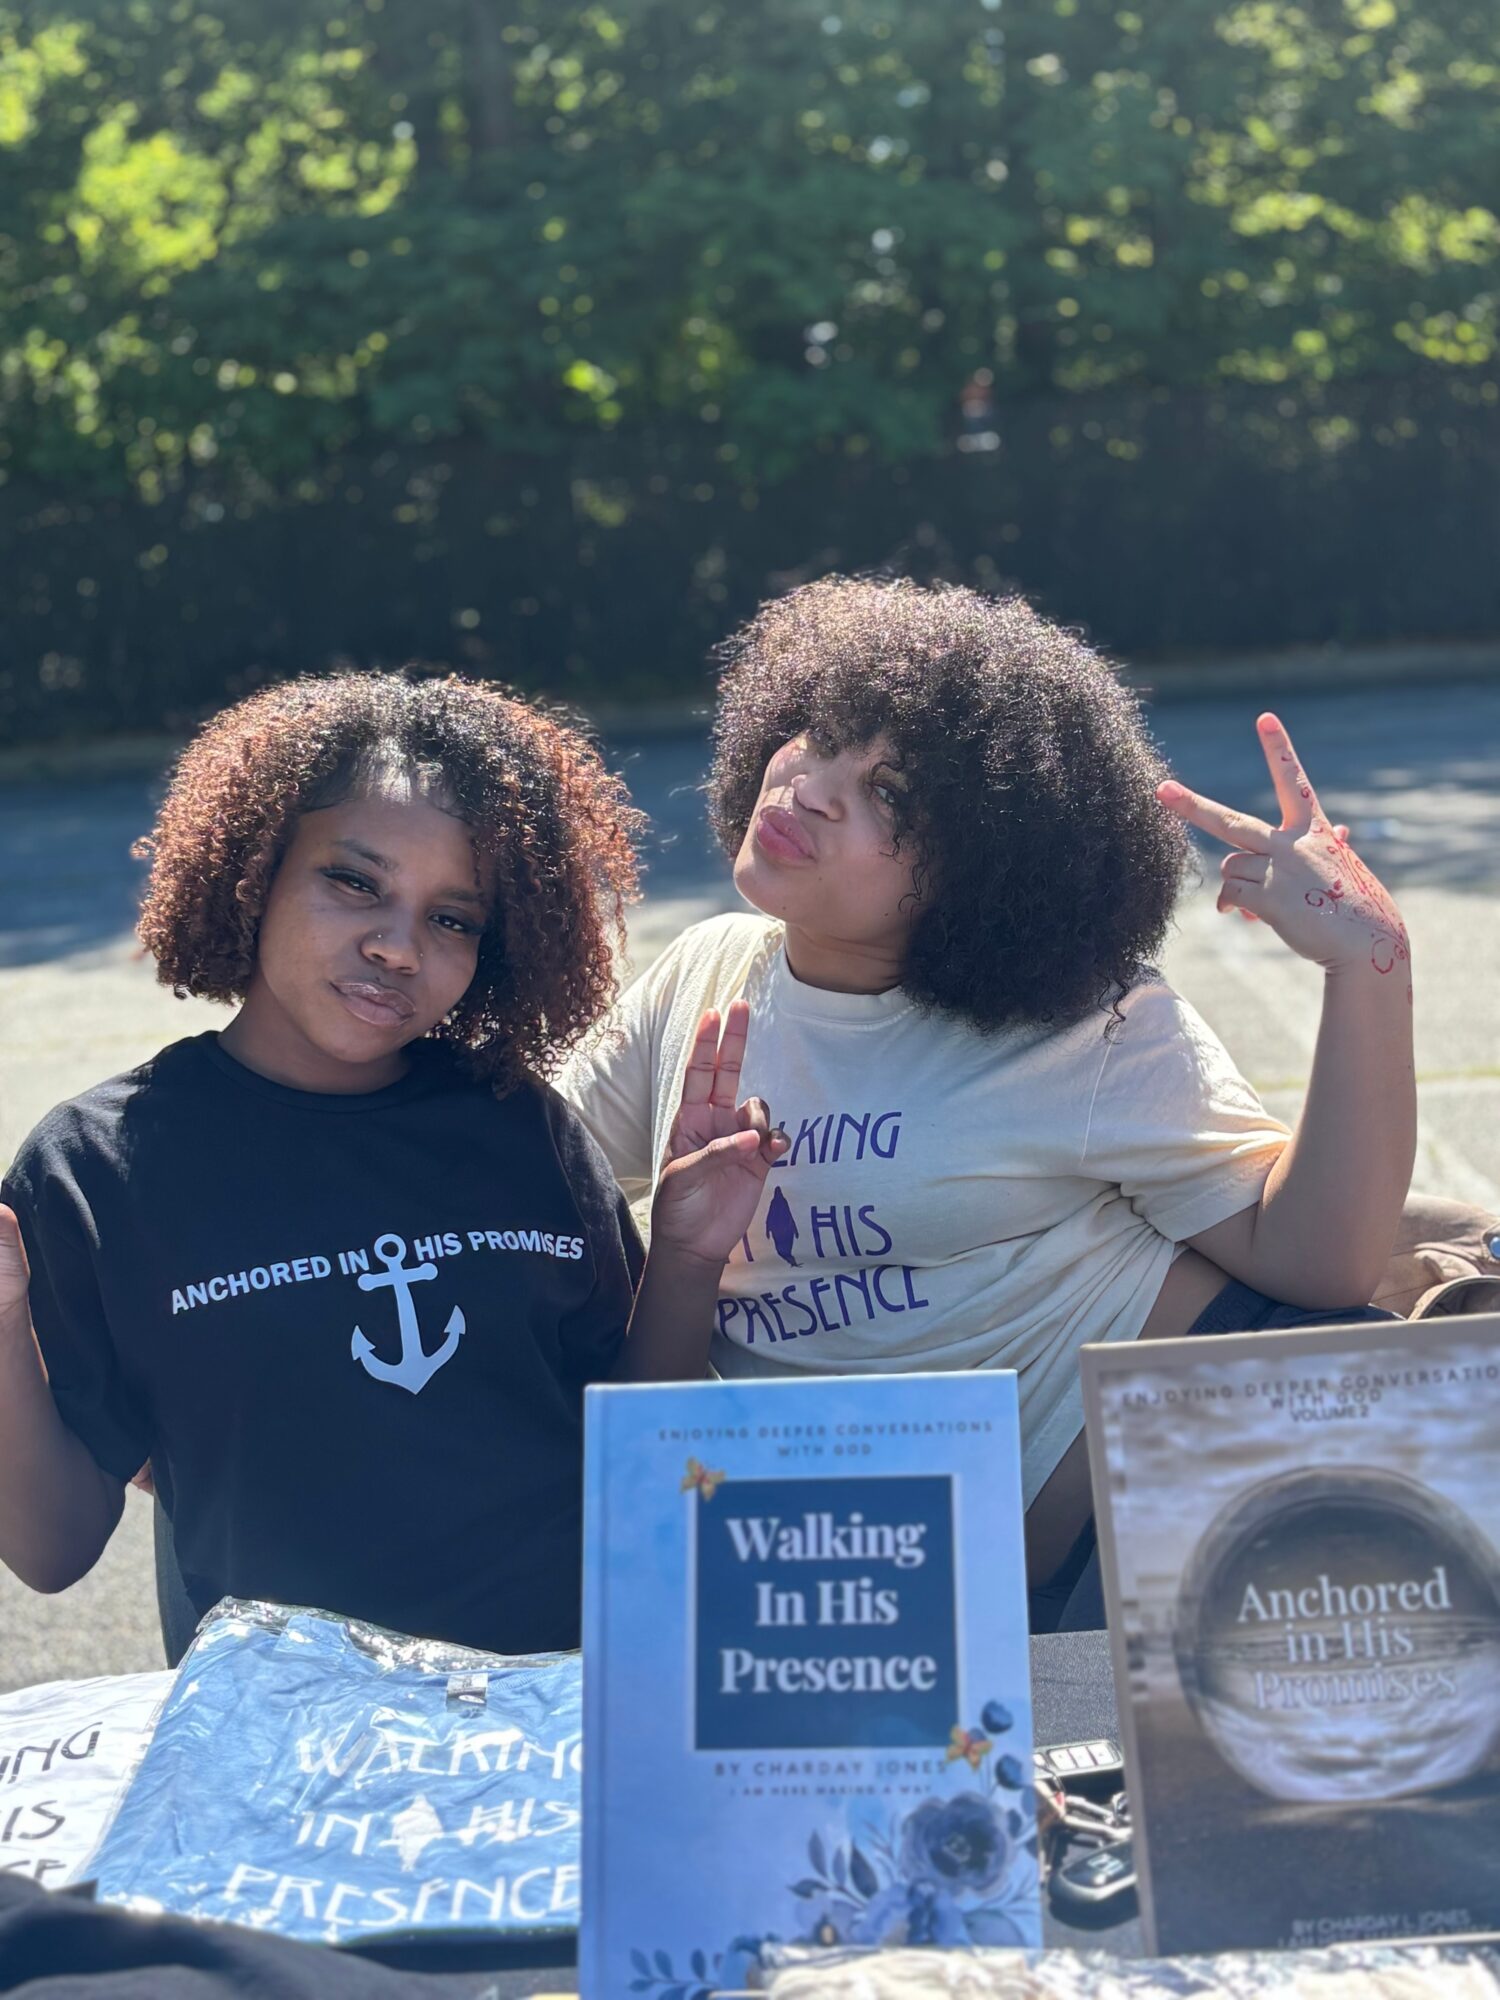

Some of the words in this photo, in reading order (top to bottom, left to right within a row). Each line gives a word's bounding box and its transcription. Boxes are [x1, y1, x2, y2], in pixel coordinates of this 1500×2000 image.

[810, 1205, 893, 1258] HIS
[171, 1256, 331, 1315] ANCHORED
[338, 1247, 370, 1275] IN
[413, 1231, 463, 1262] HIS
[466, 1229, 585, 1260] PROMISES
[1121, 1385, 1234, 1408] ENJOYING
[1244, 1377, 1328, 1399] DEEPER
[1270, 1393, 1326, 1411] WITH
[1336, 1388, 1382, 1407] GOD
[658, 1426, 750, 1442] ENJOYING
[758, 1424, 827, 1440] DEEPER
[834, 1420, 994, 1438] CONVERSATIONS
[776, 1445, 825, 1457] WITH
[833, 1444, 873, 1457] GOD
[726, 1512, 926, 1568] Walking
[755, 1582, 807, 1627] In
[816, 1577, 899, 1625] His
[1237, 1566, 1453, 1623] Anchored
[1285, 1622, 1328, 1664] in
[1341, 1617, 1415, 1660] His
[719, 1648, 937, 1693] Presence
[1254, 1661, 1457, 1709] Promises
[714, 1762, 742, 1777] BY
[753, 1760, 864, 1777] CHARDAY
[875, 1759, 948, 1777] JONES
[295, 1810, 374, 1855] IN
[460, 1798, 580, 1846] HIS
